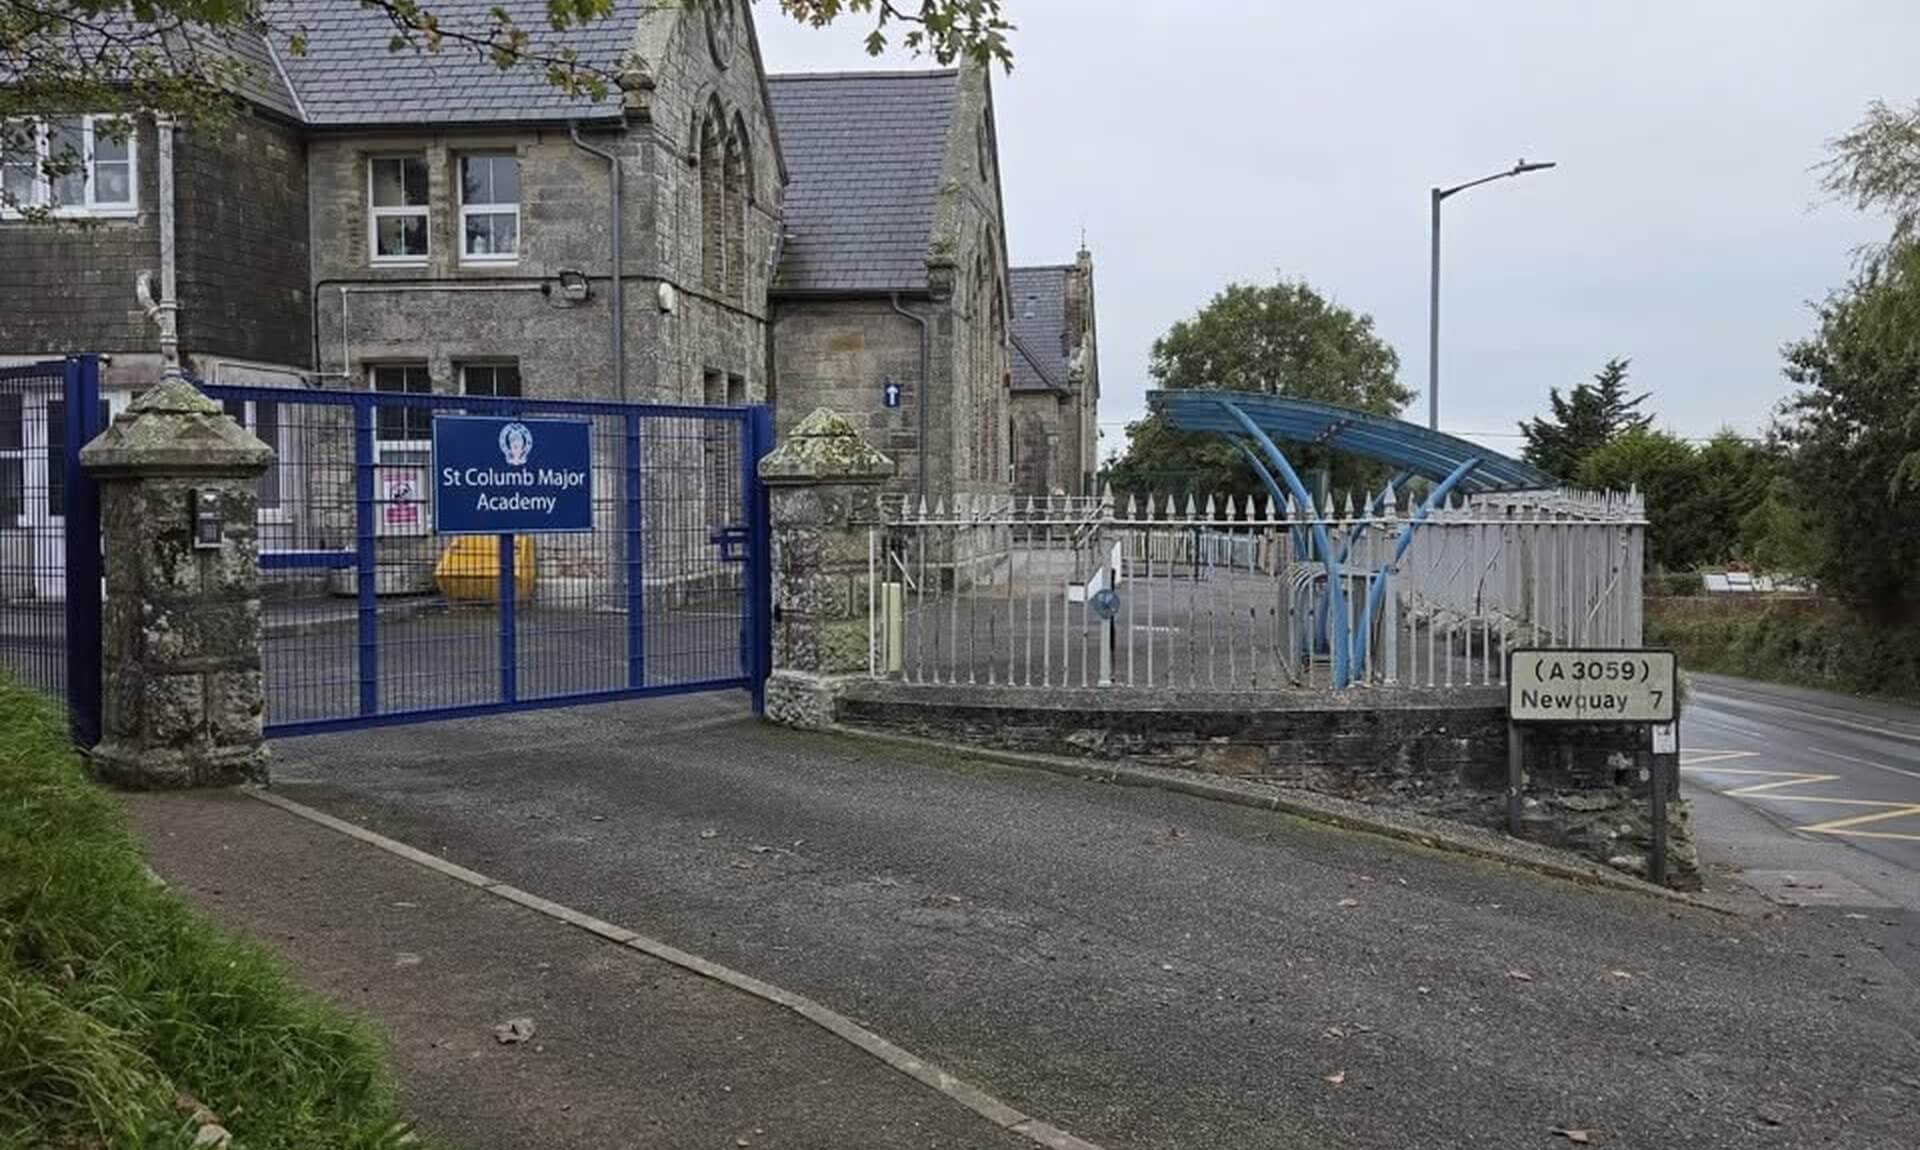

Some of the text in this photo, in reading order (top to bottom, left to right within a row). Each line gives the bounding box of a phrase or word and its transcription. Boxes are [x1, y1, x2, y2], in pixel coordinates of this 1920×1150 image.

[443, 467, 585, 490] St Columb Major
[477, 493, 557, 514] Academy
[1521, 690, 1663, 713] Newquay 7
